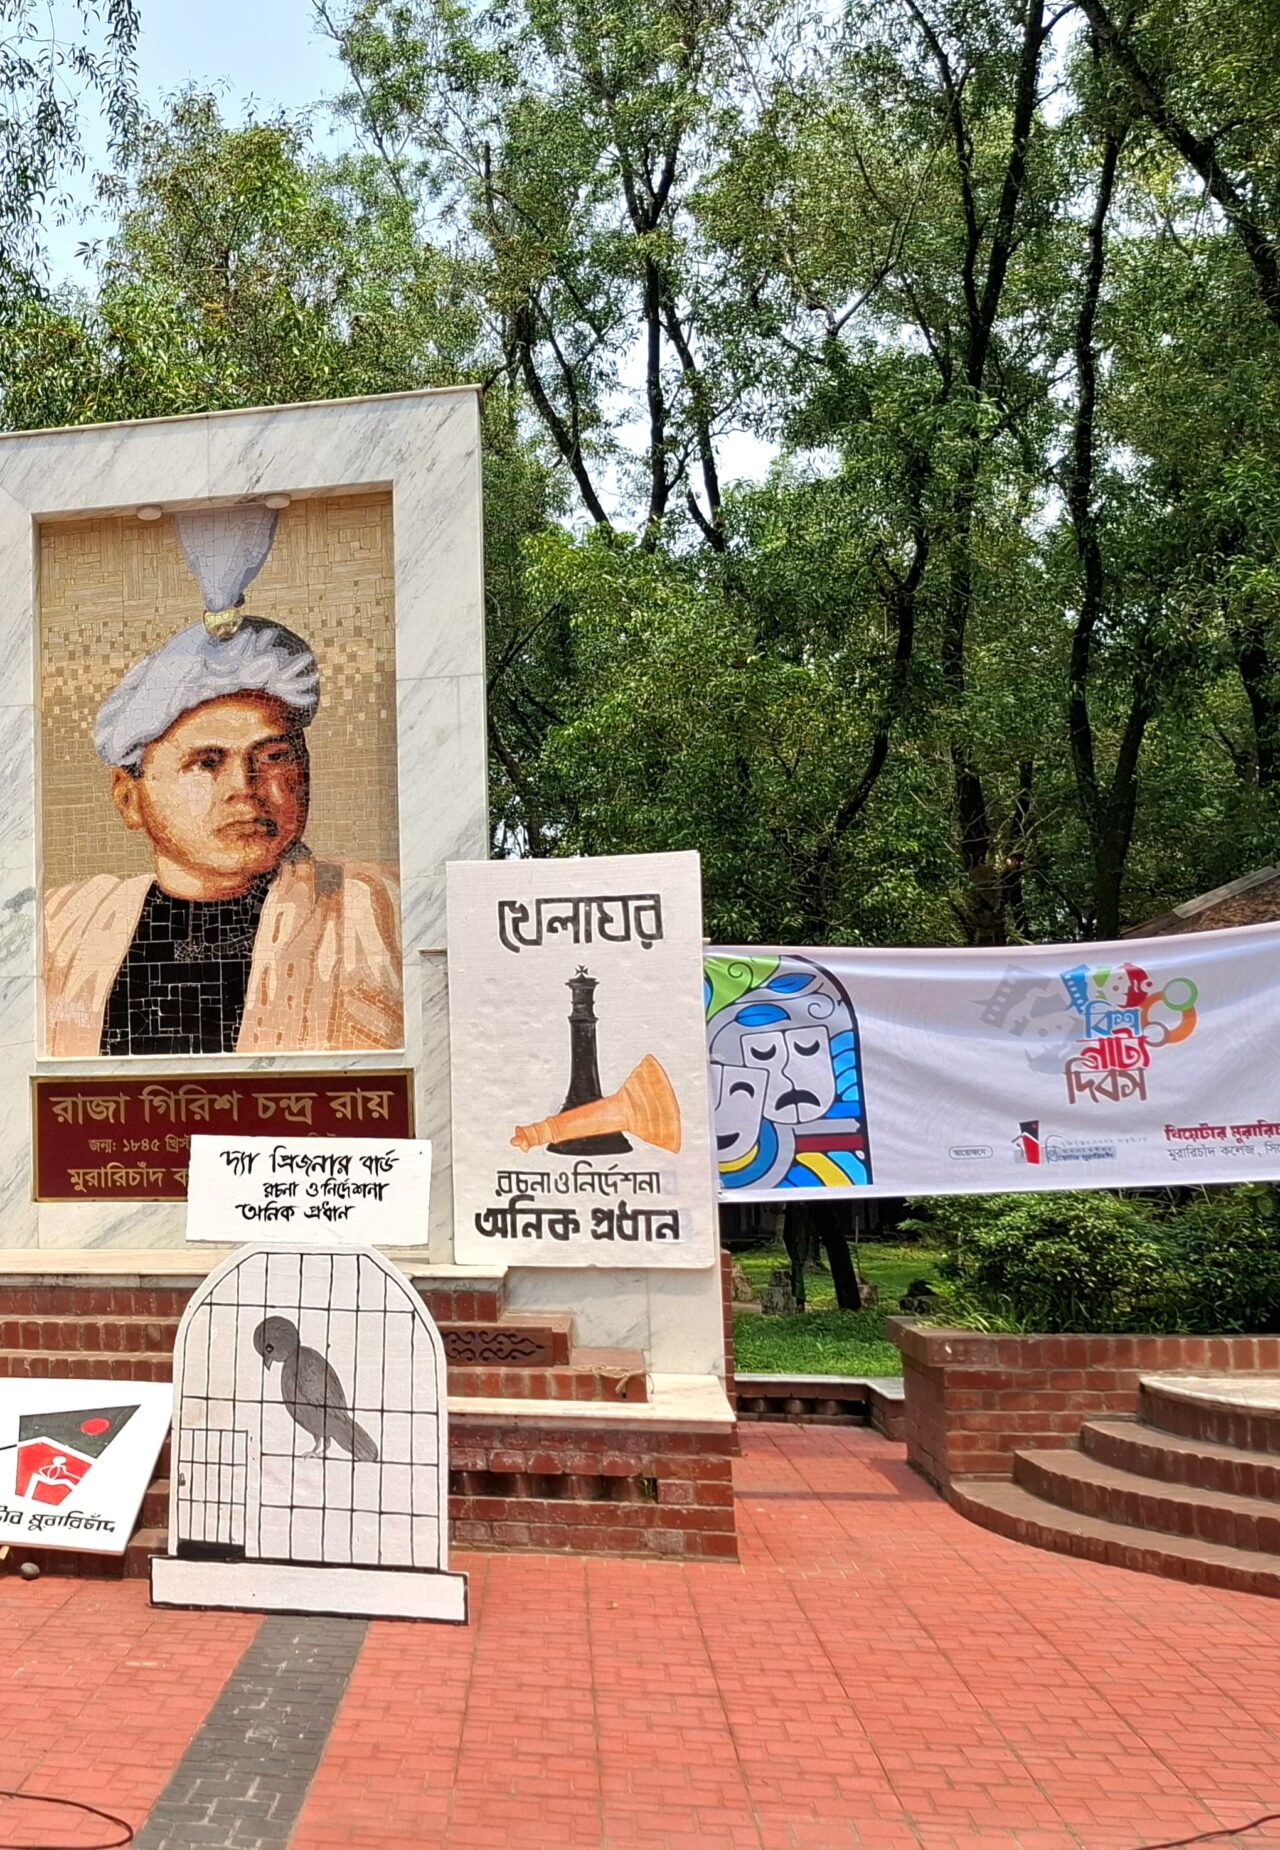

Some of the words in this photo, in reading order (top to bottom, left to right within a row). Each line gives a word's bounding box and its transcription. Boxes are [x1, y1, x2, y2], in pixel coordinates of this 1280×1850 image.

[498, 894, 663, 953] খেলাঘর
[1083, 1000, 1141, 1038] বিশ্ব
[1076, 1027, 1151, 1070] নাট্য
[1063, 1056, 1147, 1104] দিবস
[49, 1092, 131, 1125] রাজা
[138, 1084, 243, 1124] গিরিশ
[251, 1091, 318, 1125] চন্দ্র
[325, 1087, 395, 1120] রায়
[122, 1138, 160, 1152] ১৮৪৫
[1163, 1123, 1227, 1142] থিয়েটার
[67, 1161, 166, 1192] মুরারিচাঁদ
[219, 1150, 260, 1176] দ্যা
[269, 1145, 352, 1177] প্রিজনার
[359, 1149, 400, 1177] বার্ড
[263, 1181, 299, 1198] রচনা
[305, 1182, 319, 1197] ও
[320, 1177, 391, 1201] নির্দেশনা
[495, 1169, 551, 1197] রচনা
[554, 1171, 569, 1194] ও
[572, 1160, 661, 1196] নির্দেশনা
[235, 1200, 300, 1222] অনিক
[304, 1201, 356, 1222] প্রধান
[474, 1194, 580, 1241] অনিক
[590, 1199, 680, 1242] প্রধান
[28, 1510, 116, 1533] মুরারিচাঁদ
